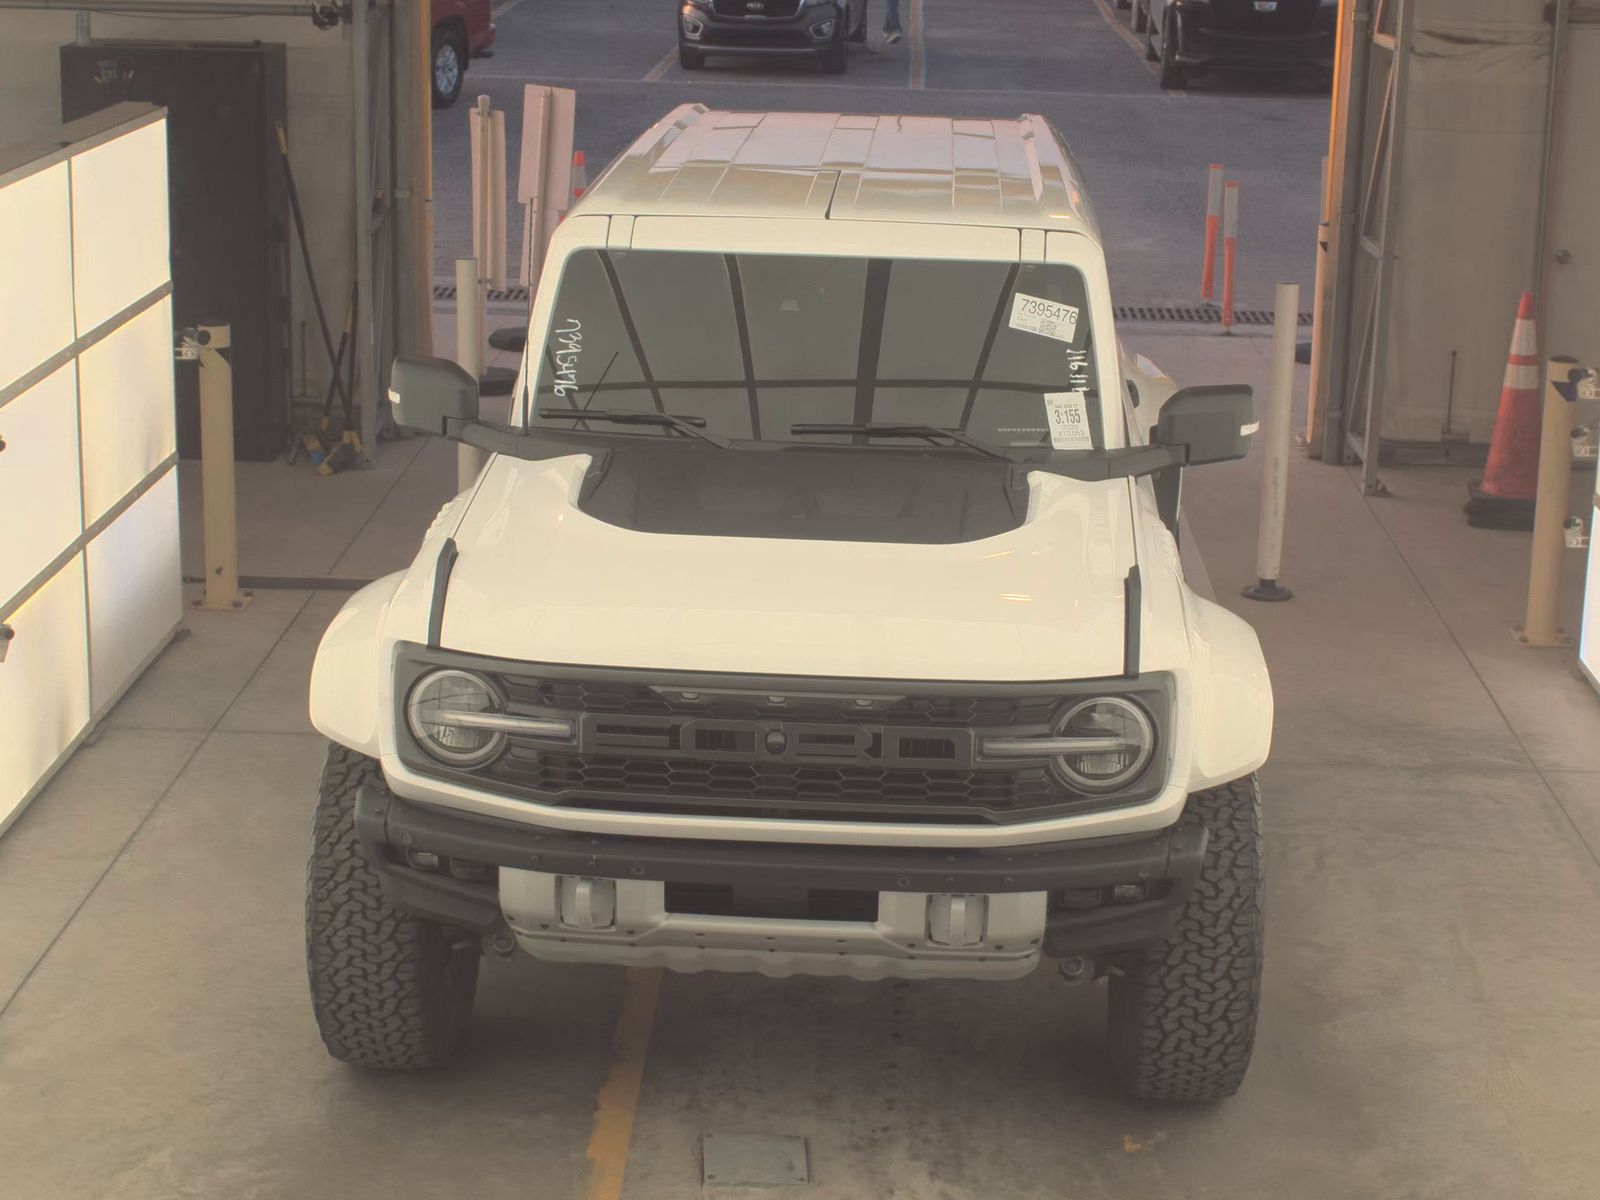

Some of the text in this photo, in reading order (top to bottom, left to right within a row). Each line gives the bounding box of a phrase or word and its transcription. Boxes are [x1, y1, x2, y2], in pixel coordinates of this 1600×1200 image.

[1021, 298, 1078, 325] 7395476
[554, 318, 582, 397] 7395476
[1054, 408, 1081, 424] 3:155
